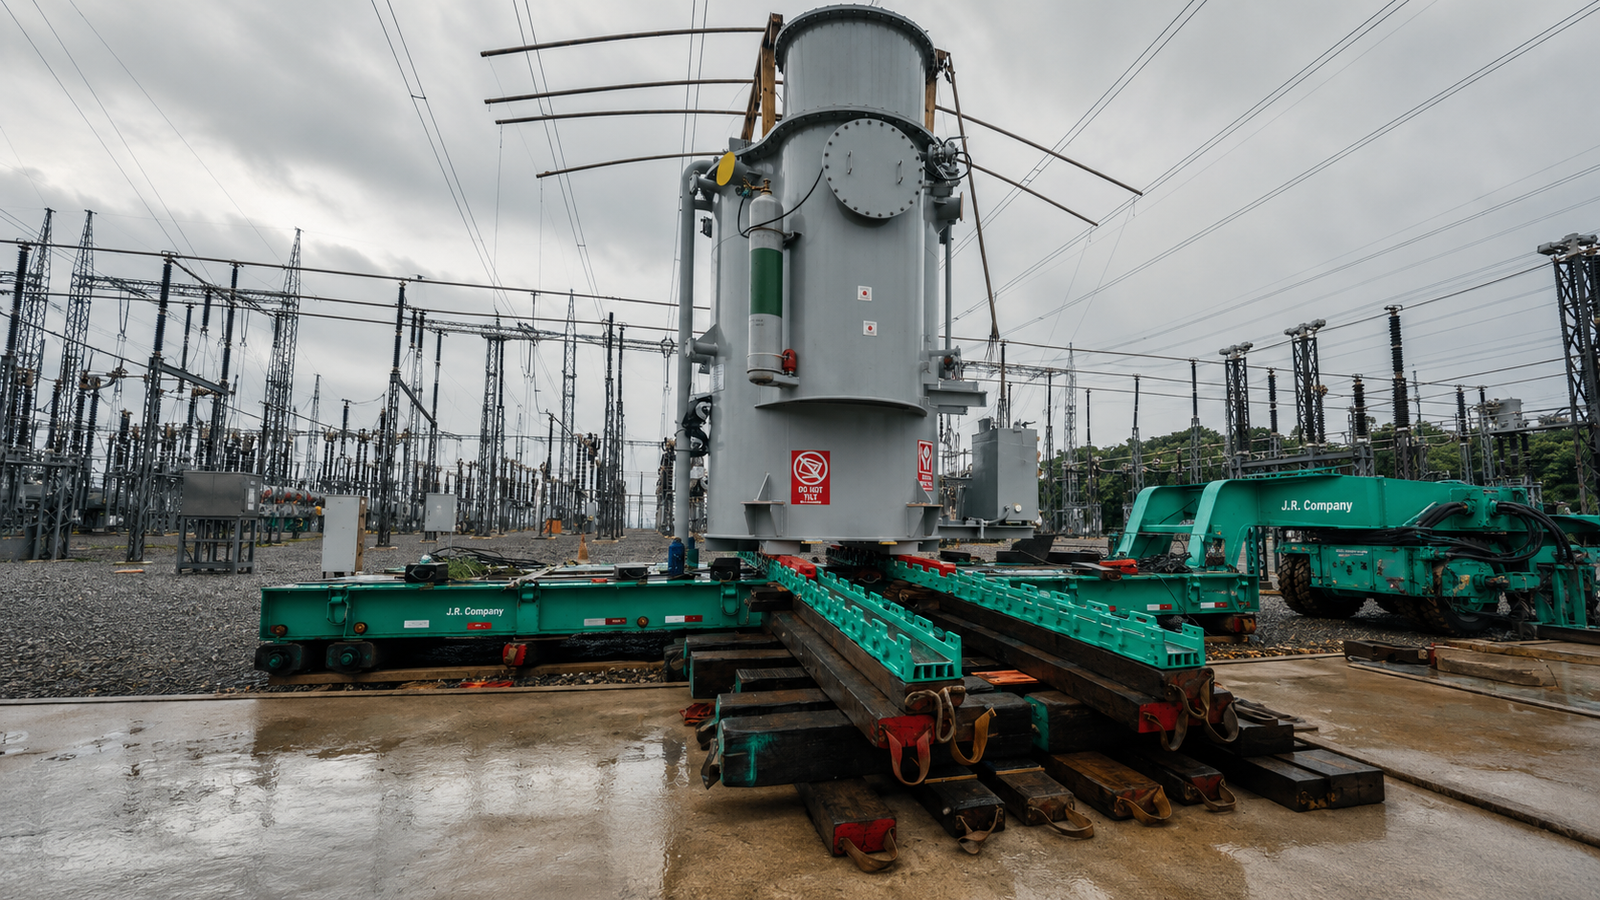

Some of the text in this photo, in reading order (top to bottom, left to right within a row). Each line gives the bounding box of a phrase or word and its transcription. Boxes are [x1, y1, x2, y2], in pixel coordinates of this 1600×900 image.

[1281, 499, 1353, 514] J.R. Company
[446, 606, 504, 617] J.R. Company
